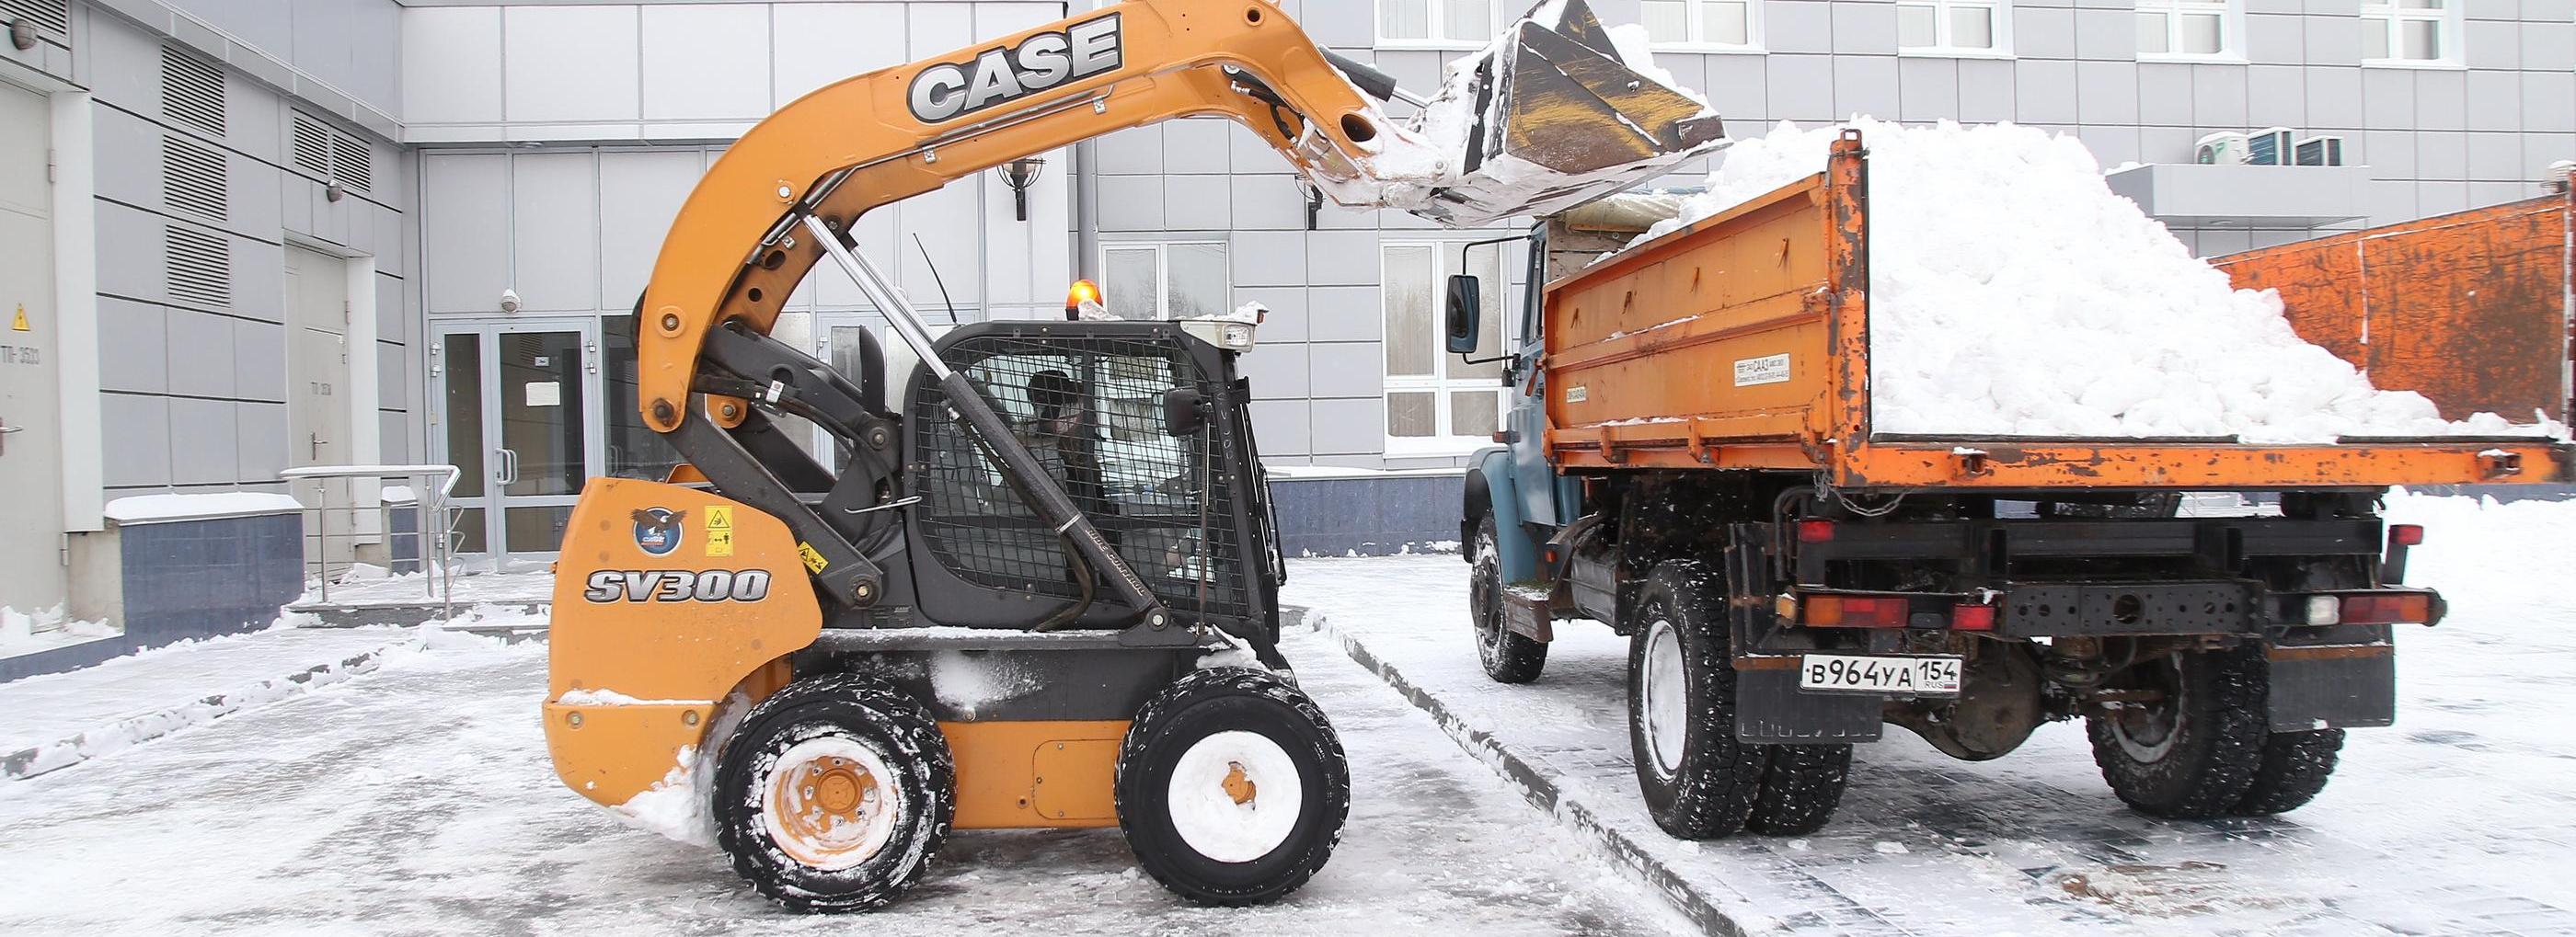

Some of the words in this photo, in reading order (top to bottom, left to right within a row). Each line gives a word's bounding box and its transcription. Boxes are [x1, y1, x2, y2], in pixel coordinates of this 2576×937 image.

[908, 12, 1121, 122] CASE
[584, 569, 771, 602] SV300
[1918, 660, 1957, 681] 154
[1925, 680, 1944, 690] RUS
